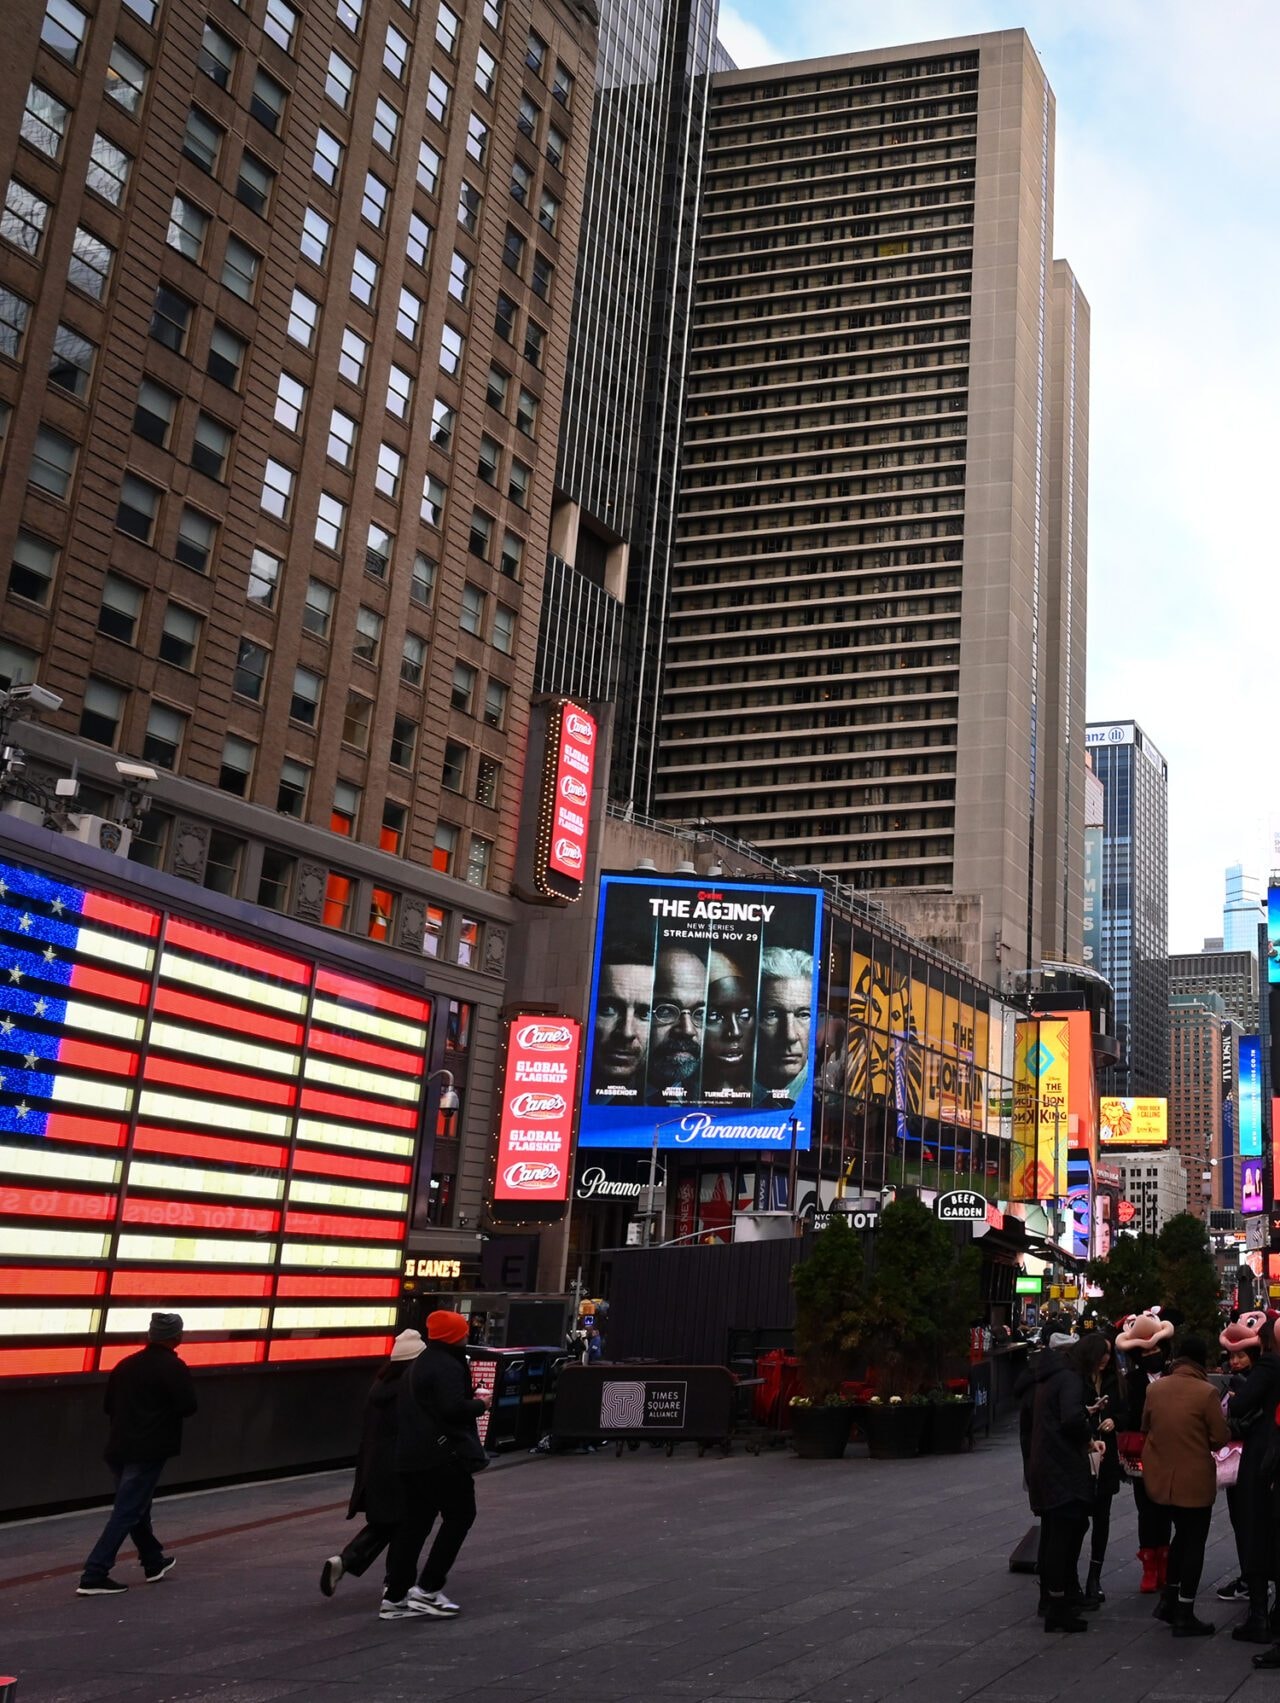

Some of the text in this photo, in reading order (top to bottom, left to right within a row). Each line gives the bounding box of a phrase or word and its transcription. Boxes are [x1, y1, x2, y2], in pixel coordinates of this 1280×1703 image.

[564, 744, 590, 766] GLOBAL
[649, 898, 775, 922] THE AGENCY
[708, 923, 735, 931] SERIES
[663, 929, 758, 941] STREAMING NOV 29
[517, 1025, 572, 1050] Cane's
[516, 1061, 568, 1073] GLOBAL
[515, 1072, 568, 1083] FLAGSHIP
[1046, 1083, 1062, 1091] THE
[511, 1093, 566, 1118] Cane's
[510, 1130, 562, 1142] GLOBAL
[508, 1141, 562, 1152] FLAGSHIP
[504, 1162, 560, 1189] Cane's
[951, 1193, 975, 1205] BEER
[943, 1206, 982, 1217] GARDEN
[417, 1260, 461, 1277] CANE'S
[651, 1391, 679, 1400] TIMES
[647, 1401, 681, 1411] SQUARE
